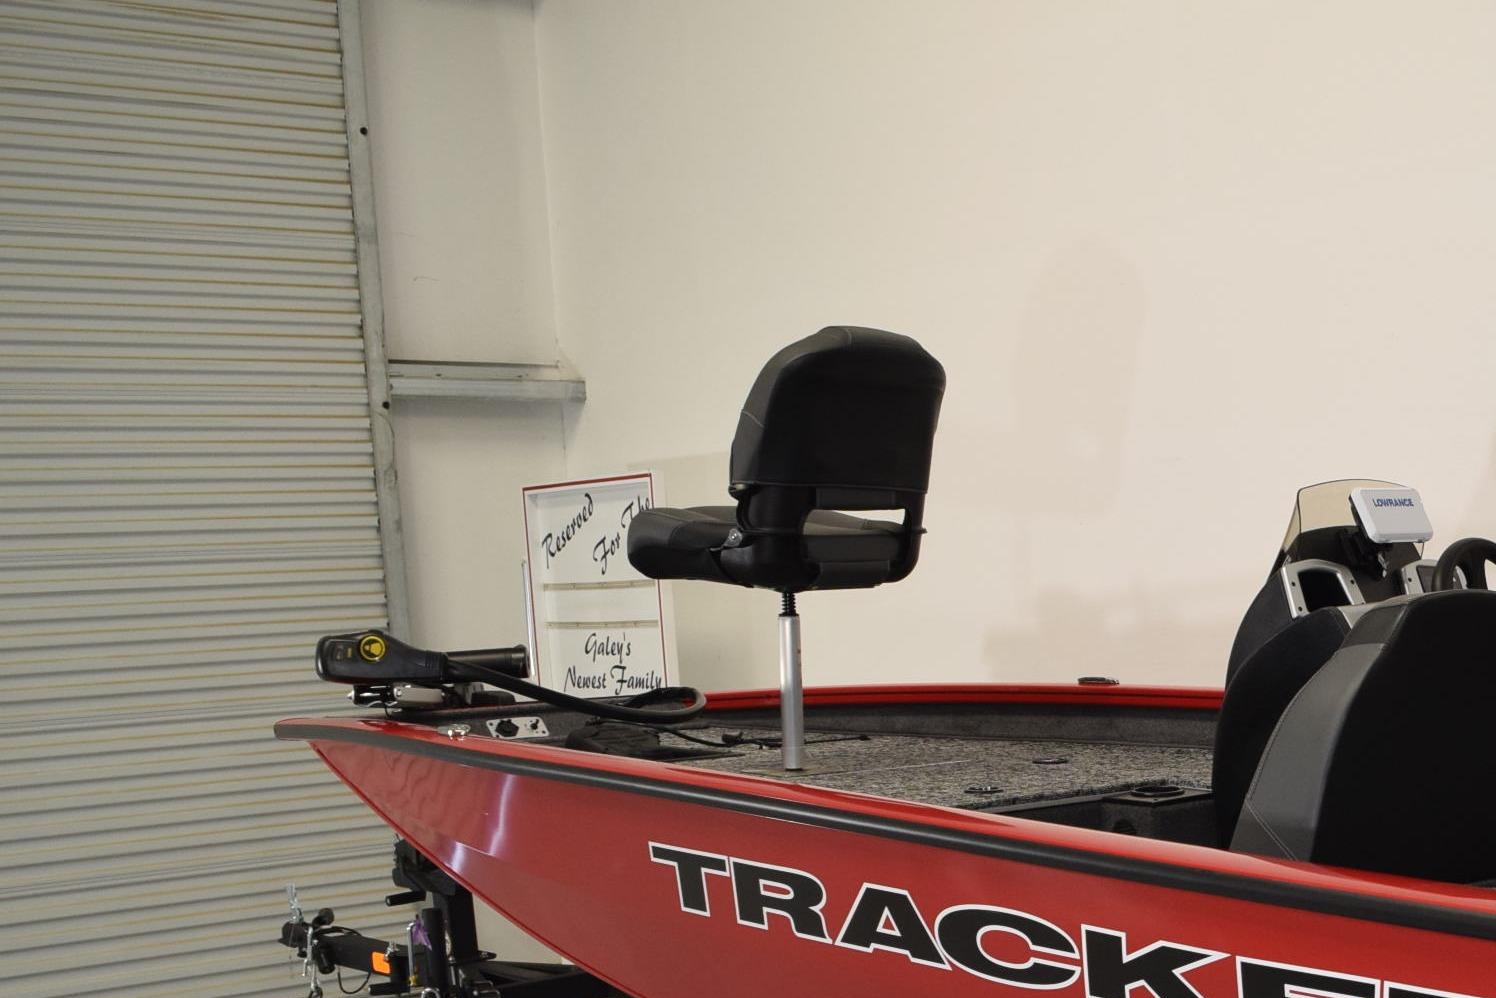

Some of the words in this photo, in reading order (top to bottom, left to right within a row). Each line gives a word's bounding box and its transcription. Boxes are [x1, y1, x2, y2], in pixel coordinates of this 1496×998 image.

[1373, 498, 1415, 507] LOWRANCE
[541, 492, 594, 570] Reserved
[592, 535, 621, 576] For
[584, 632, 632, 663] Galey's
[563, 664, 607, 694] Newest
[609, 664, 662, 696] Family
